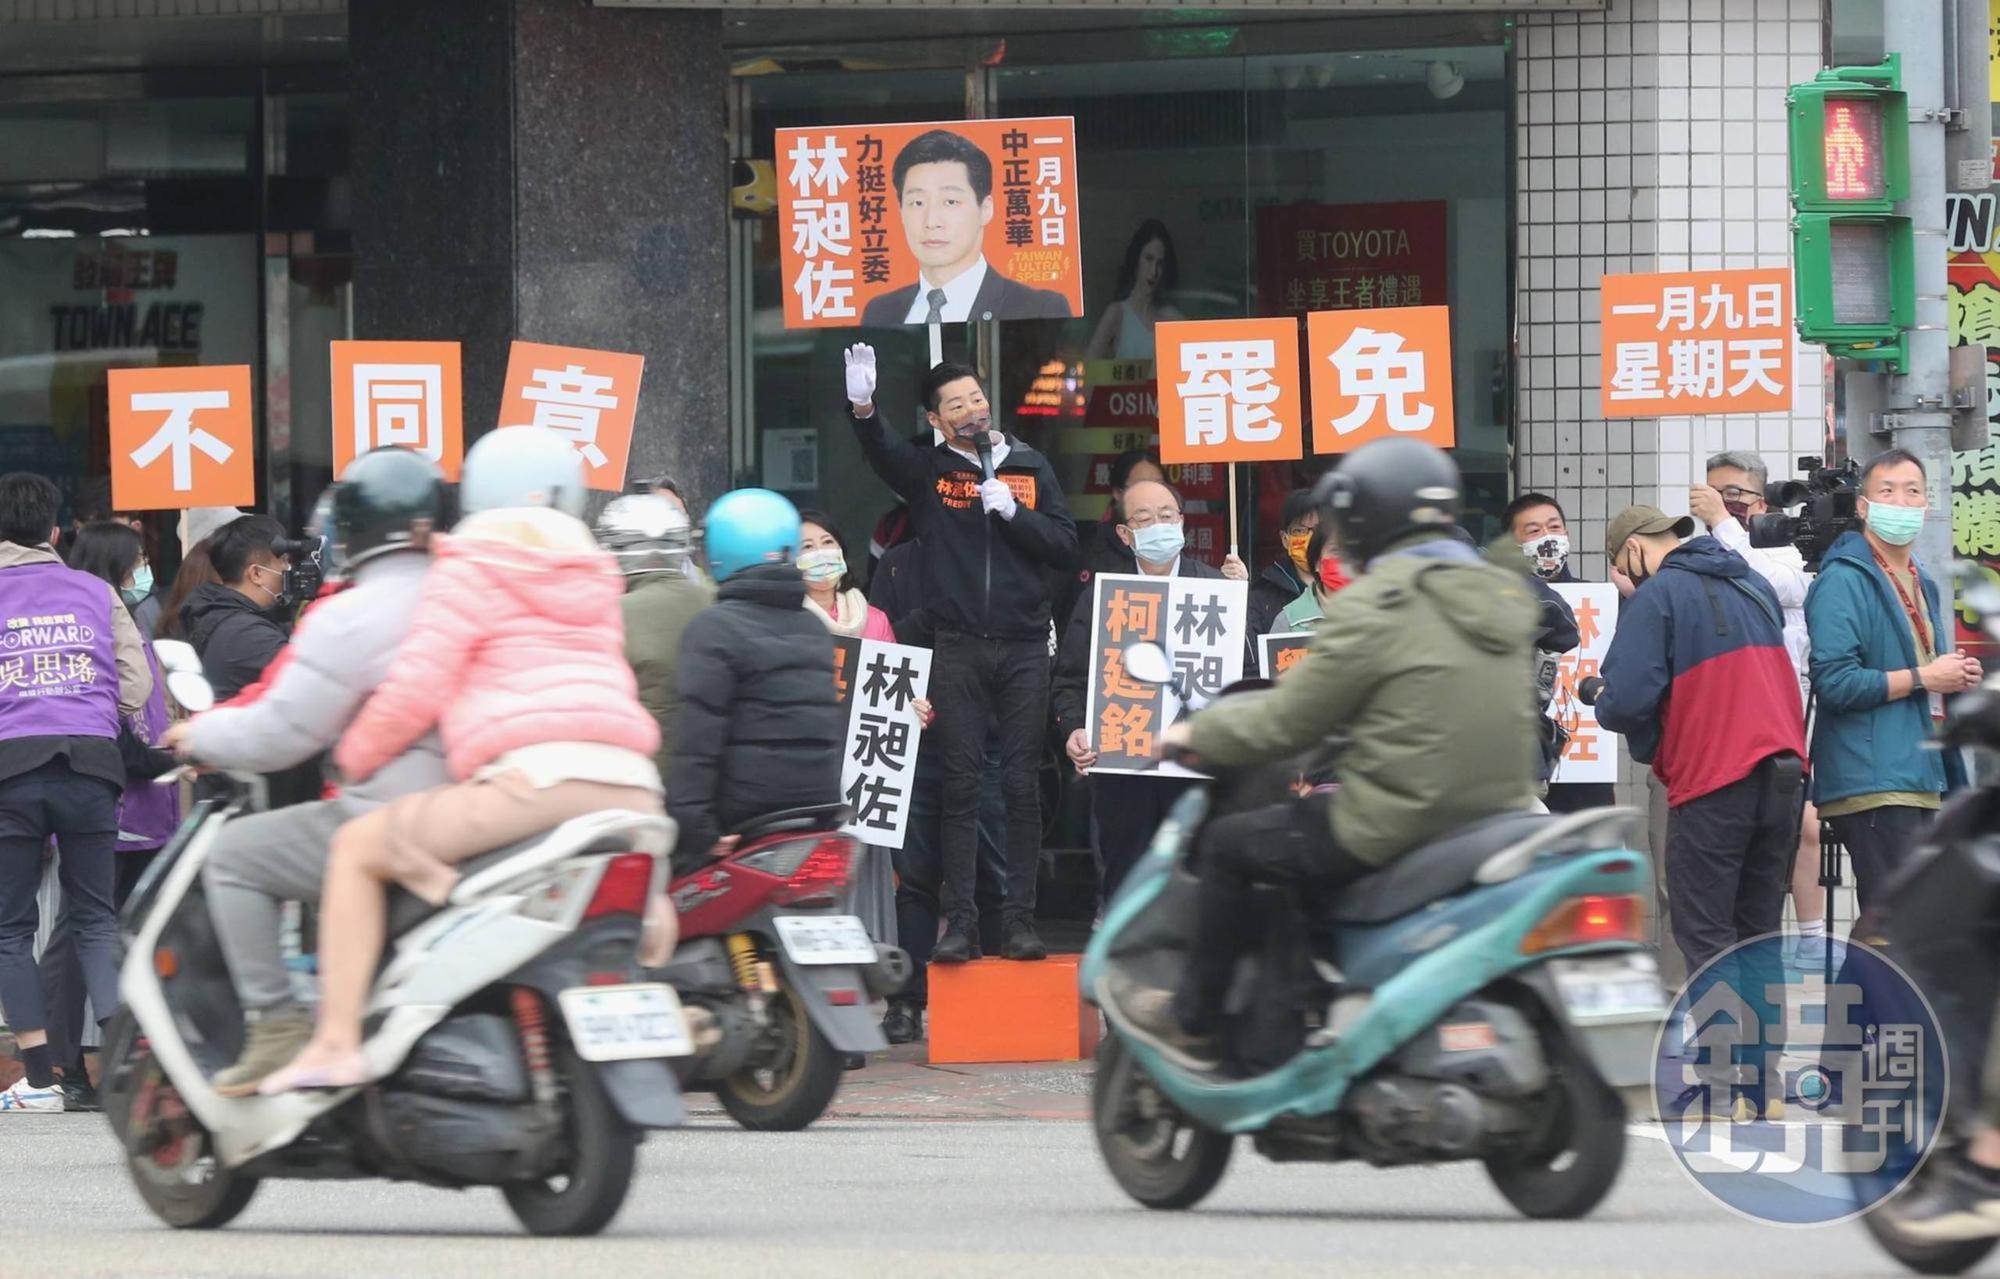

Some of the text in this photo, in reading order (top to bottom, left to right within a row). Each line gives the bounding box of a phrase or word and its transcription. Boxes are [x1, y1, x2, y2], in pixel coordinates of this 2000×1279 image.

[788, 135, 856, 321] 林昶佐
[856, 134, 890, 284] 力挺好立委
[1001, 128, 1033, 247] 中正萬華
[1032, 135, 1067, 246] 一月九日
[1014, 251, 1062, 262] TAIWAN
[1018, 260, 1061, 272] ULTRA
[1287, 275, 1422, 309] 坐享王者禮遇
[50, 301, 204, 351] TOWN ACE
[1612, 283, 1782, 332] 一月九日
[353, 363, 442, 463] 同
[521, 364, 620, 469] 意
[1176, 338, 1283, 446] 罷
[1328, 327, 1435, 436] 免
[1610, 338, 1784, 400] 星期天
[129, 390, 234, 490] 不
[0, 626, 94, 649] ORWARD
[846, 653, 919, 831] 林昶佐
